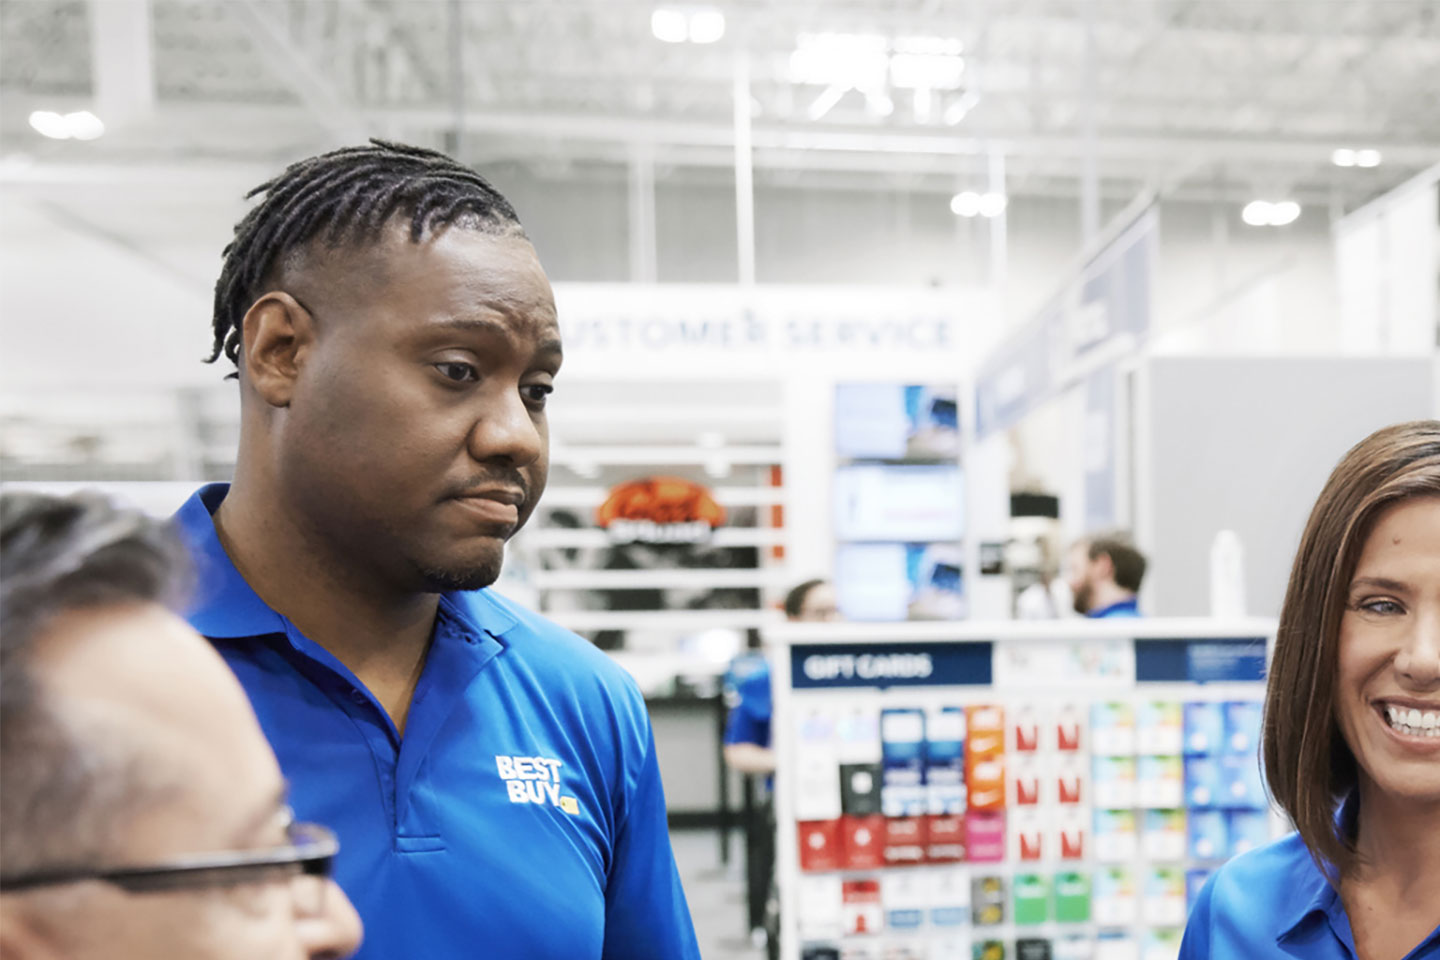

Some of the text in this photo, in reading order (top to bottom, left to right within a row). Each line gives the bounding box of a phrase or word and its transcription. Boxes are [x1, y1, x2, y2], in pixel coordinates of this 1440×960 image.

[562, 316, 956, 352] USTOMER SERVICE
[803, 653, 932, 680] GIFT CARDS
[495, 755, 562, 783] BEST
[506, 780, 560, 807] BUY
